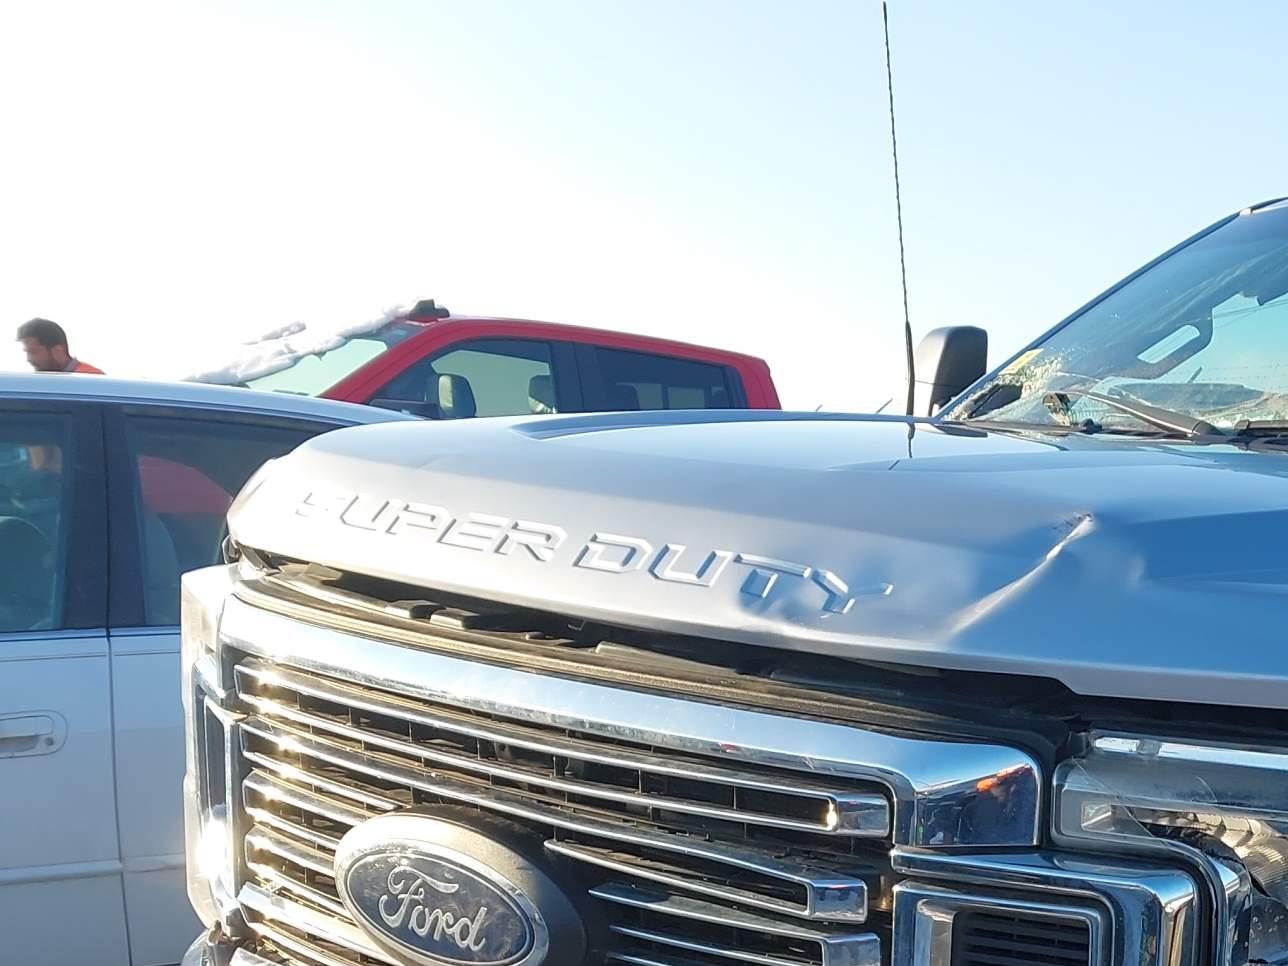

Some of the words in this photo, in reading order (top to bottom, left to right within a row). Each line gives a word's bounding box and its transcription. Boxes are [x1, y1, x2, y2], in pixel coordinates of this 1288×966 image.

[294, 489, 569, 562] SUPER
[575, 530, 893, 618] DUTY
[378, 865, 487, 952] Ford
